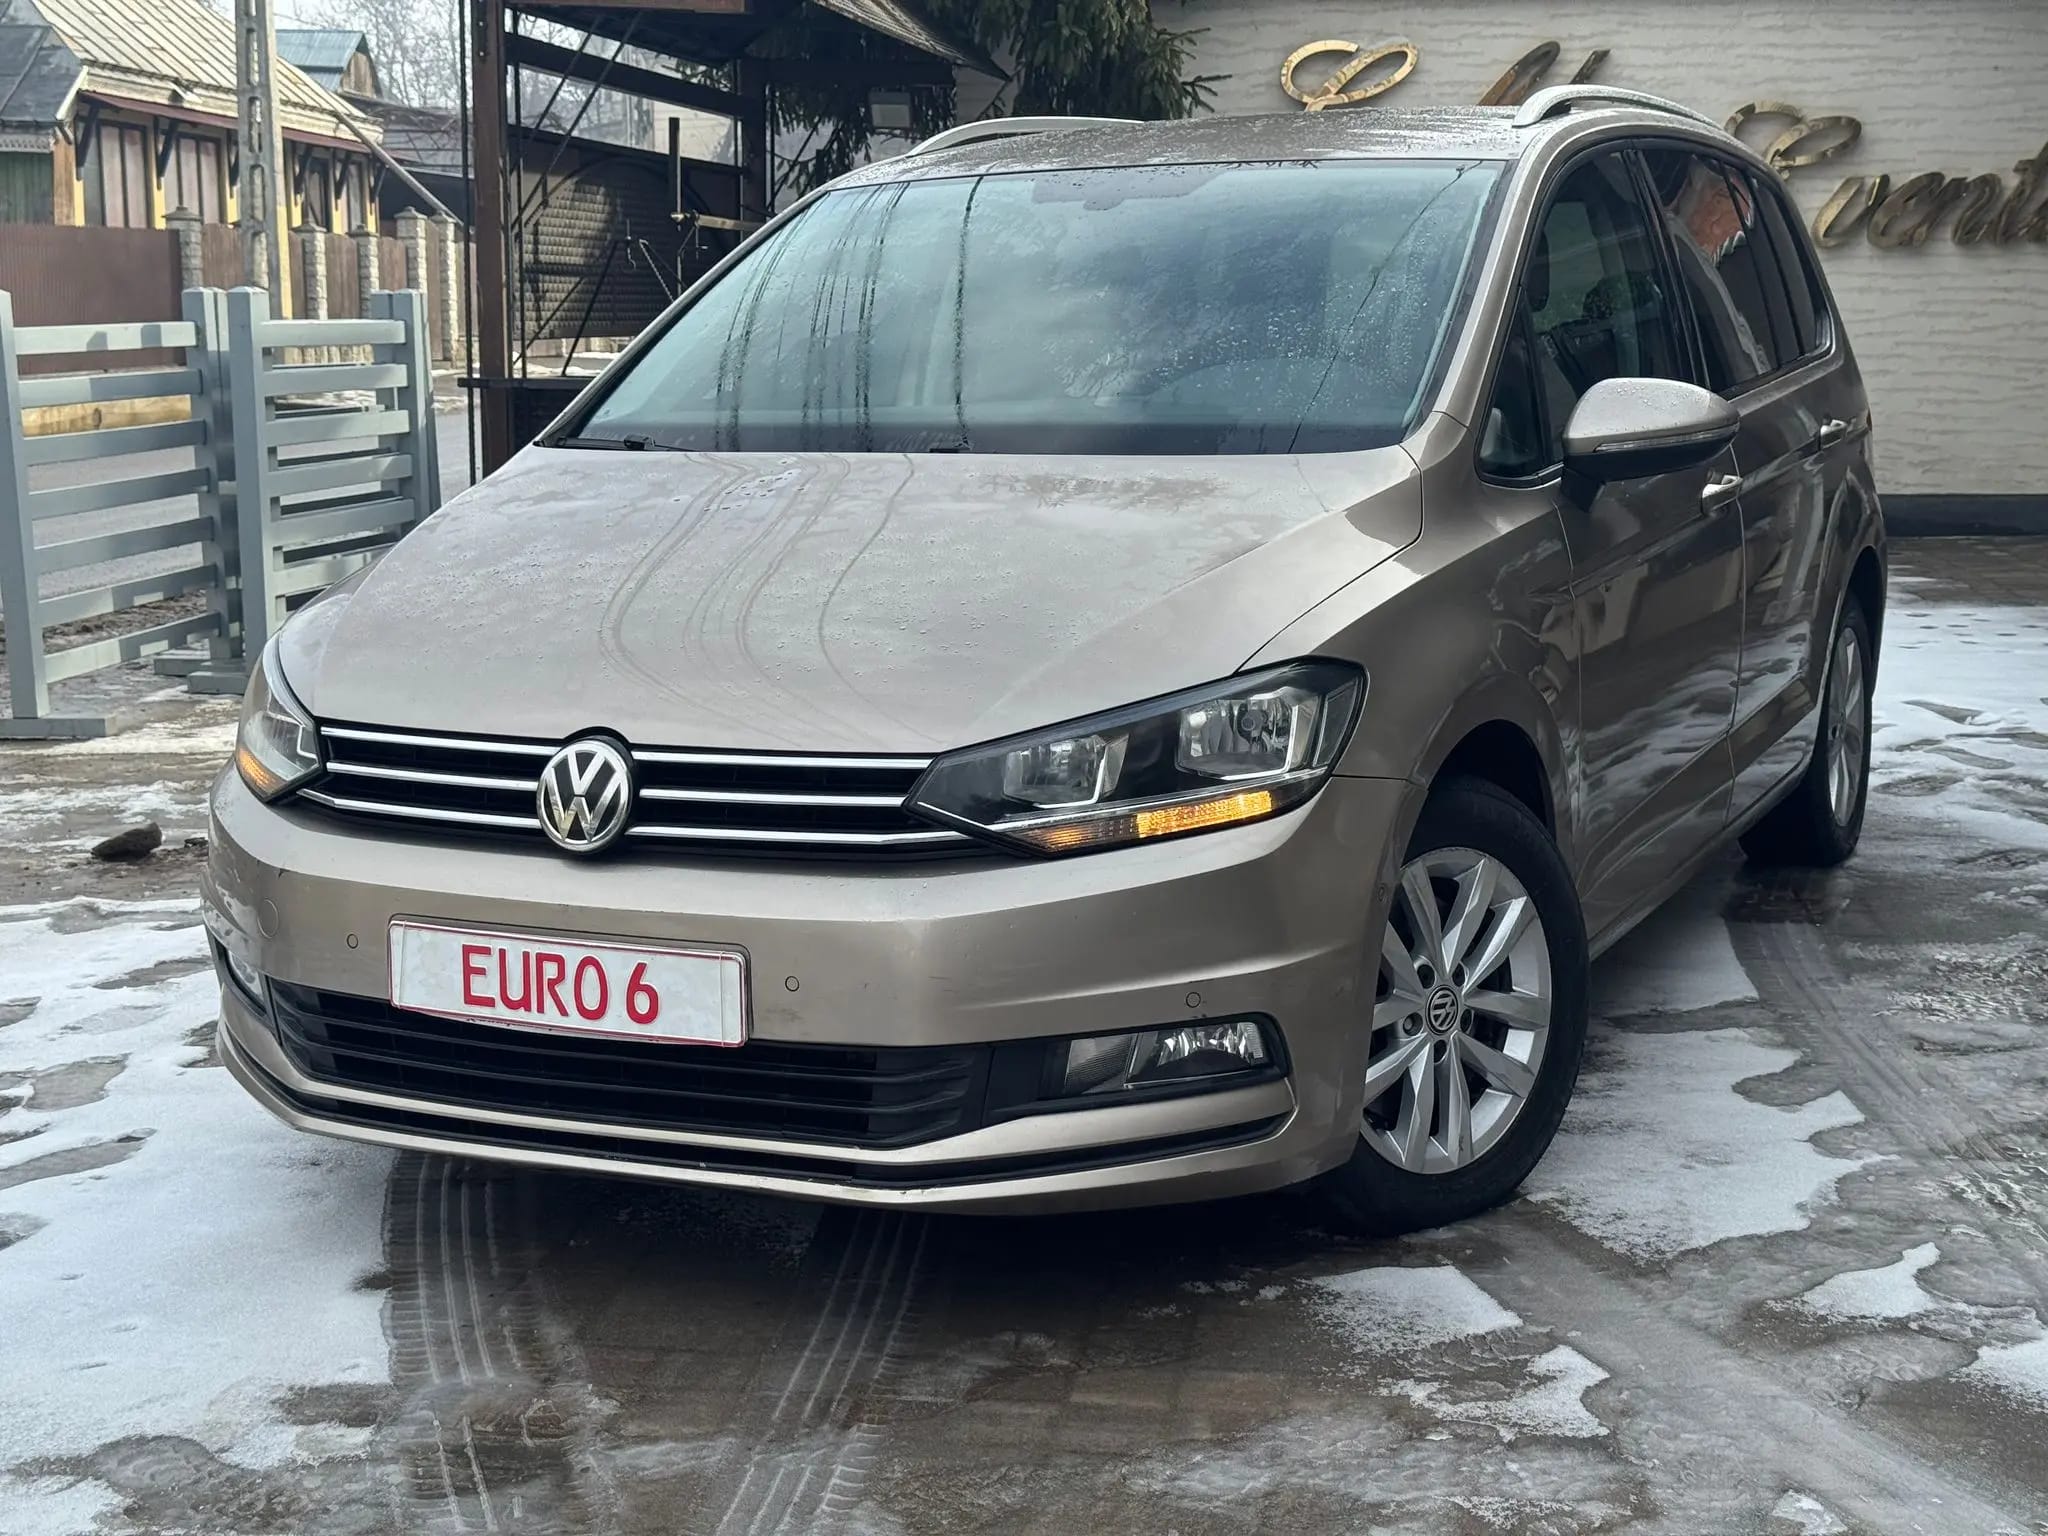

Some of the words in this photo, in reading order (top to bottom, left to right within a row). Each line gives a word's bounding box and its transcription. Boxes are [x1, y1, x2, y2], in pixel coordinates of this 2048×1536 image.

[542, 744, 626, 847] VW
[461, 943, 609, 1021] EURO
[626, 961, 660, 1025] 6
